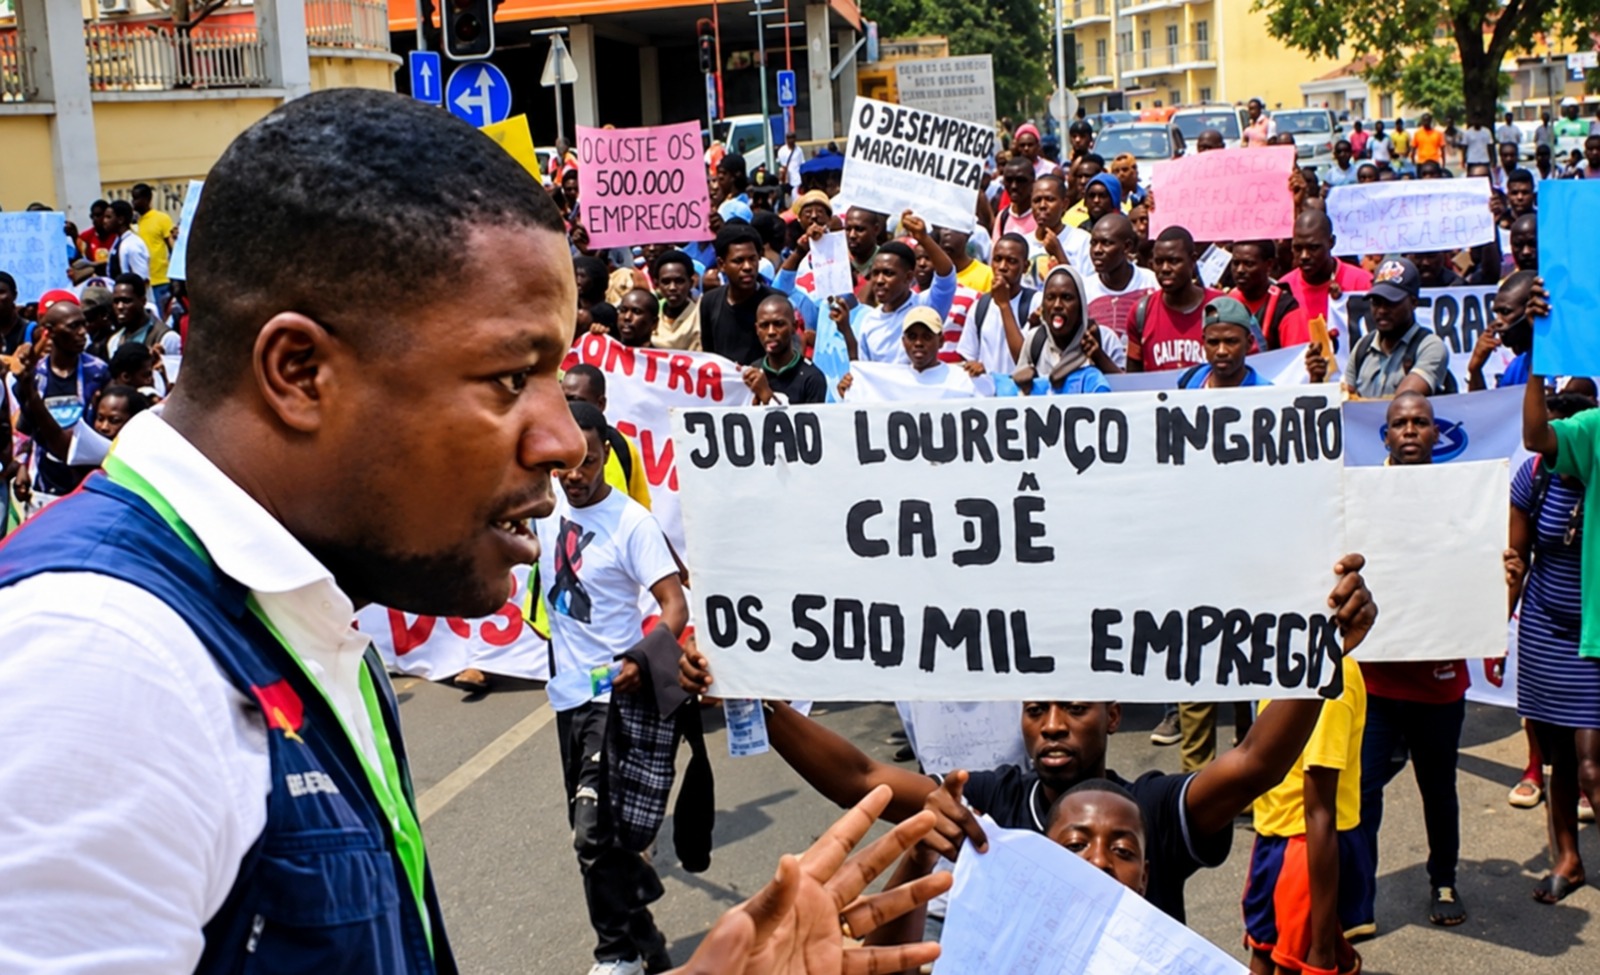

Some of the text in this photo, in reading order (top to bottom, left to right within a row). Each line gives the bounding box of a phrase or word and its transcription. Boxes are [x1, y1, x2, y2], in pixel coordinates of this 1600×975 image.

[667, 132, 695, 160] OS
[859, 103, 994, 159] O DESEMPREGO
[596, 168, 684, 197] 500.000
[851, 134, 982, 190] MARGINALIZA
[854, 404, 1129, 475] LOURENÇO
[705, 594, 771, 652] OS
[792, 594, 905, 668] 500
[918, 605, 1055, 673] MIL
[1091, 605, 1344, 700] EMPREGOS
